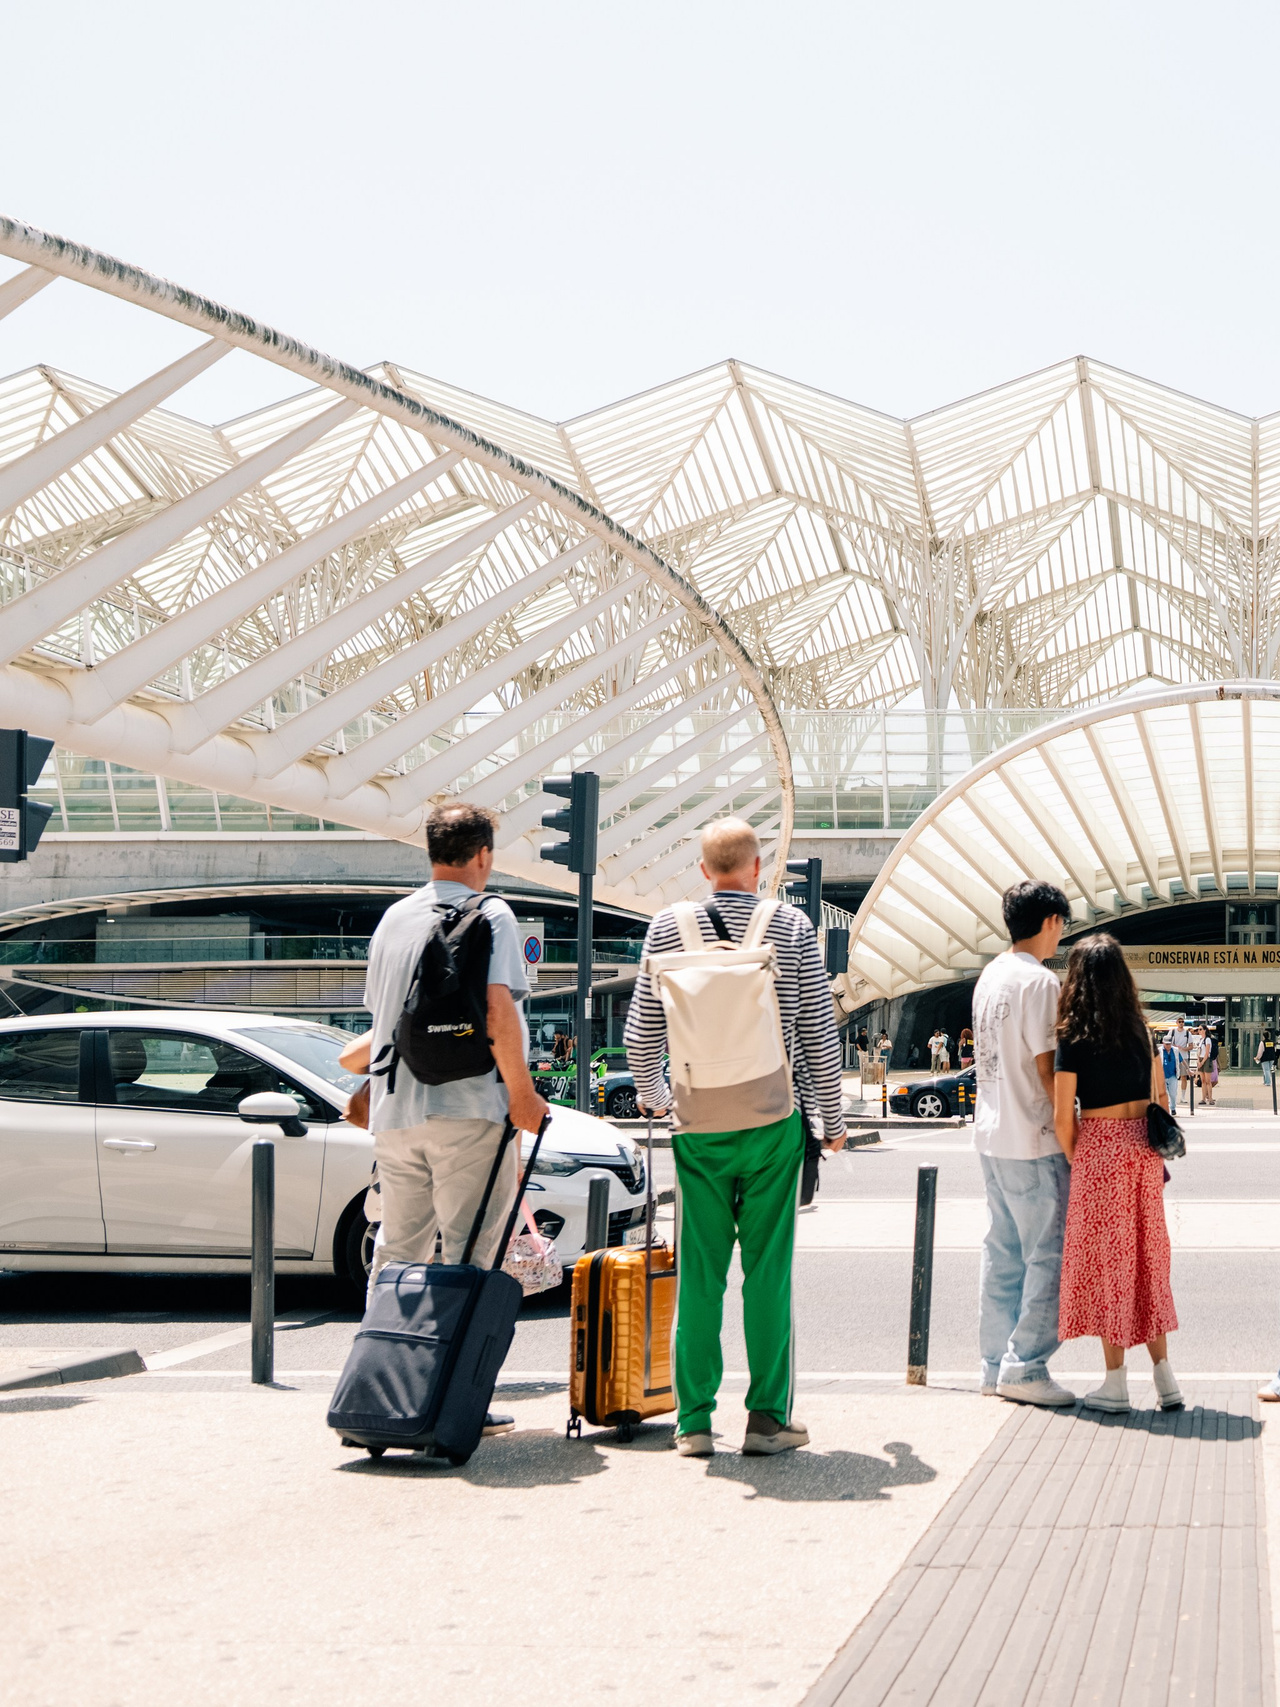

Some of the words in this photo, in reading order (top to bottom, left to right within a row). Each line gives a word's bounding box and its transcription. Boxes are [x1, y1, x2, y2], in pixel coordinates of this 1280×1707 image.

[1148, 951, 1210, 964] CONSERVAR
[1213, 949, 1239, 964] ESTÁ
[1243, 951, 1258, 964] NA
